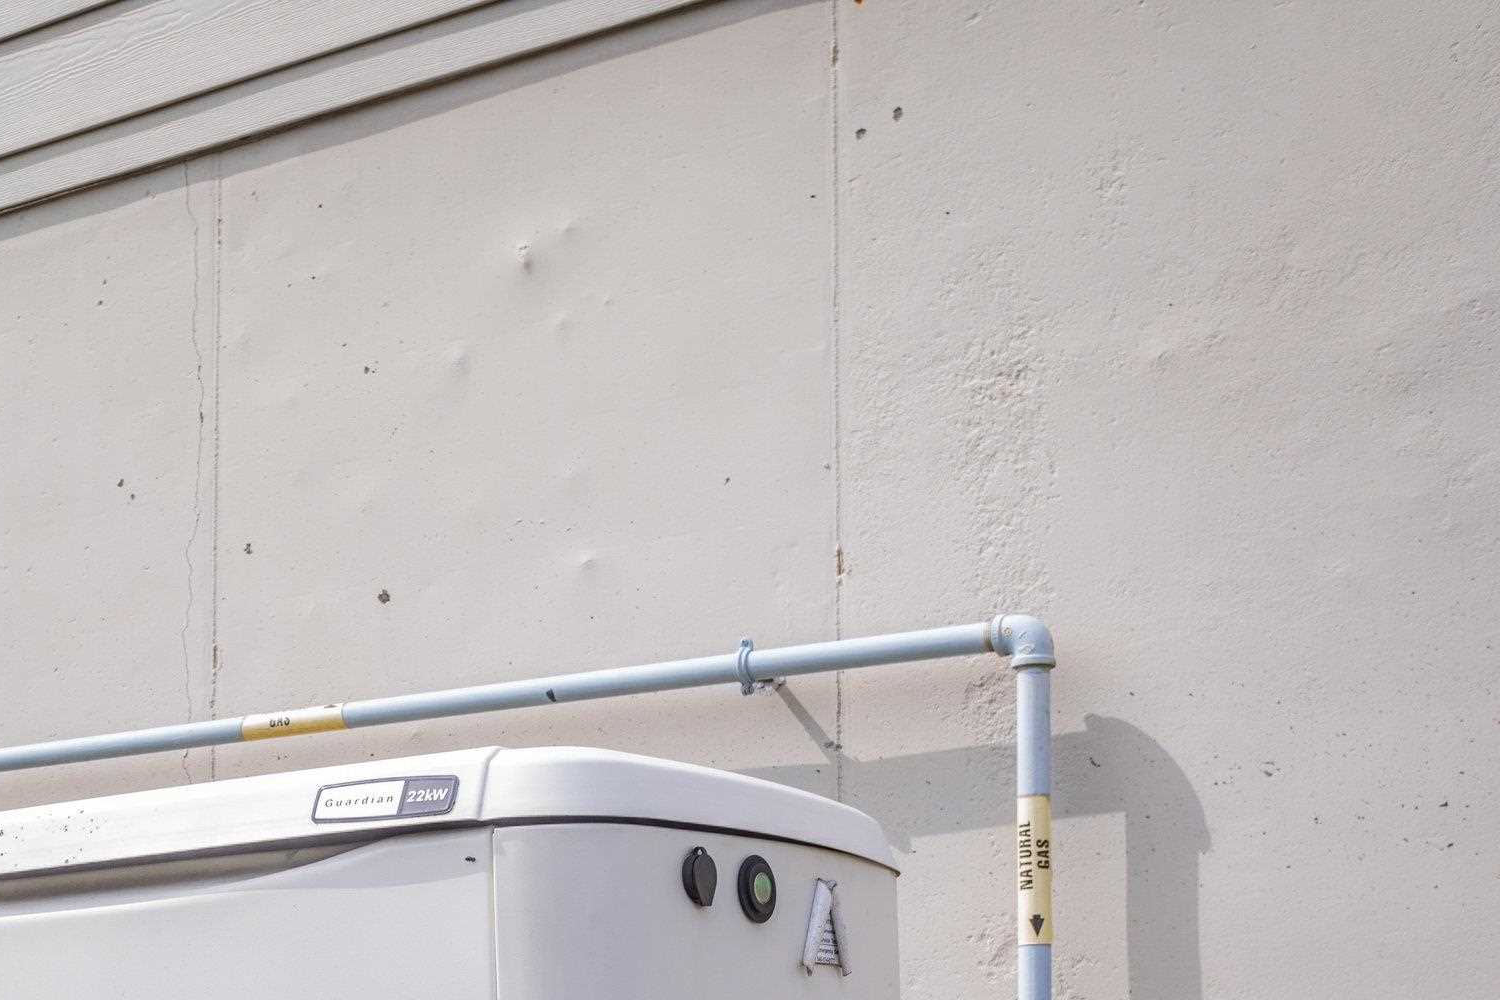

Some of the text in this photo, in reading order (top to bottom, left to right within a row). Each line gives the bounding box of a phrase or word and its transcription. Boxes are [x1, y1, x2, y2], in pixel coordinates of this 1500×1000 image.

[325, 788, 450, 808] Guardian 22kW
[1018, 820, 1034, 891] NATURAL
[1036, 838, 1050, 870] GAS
